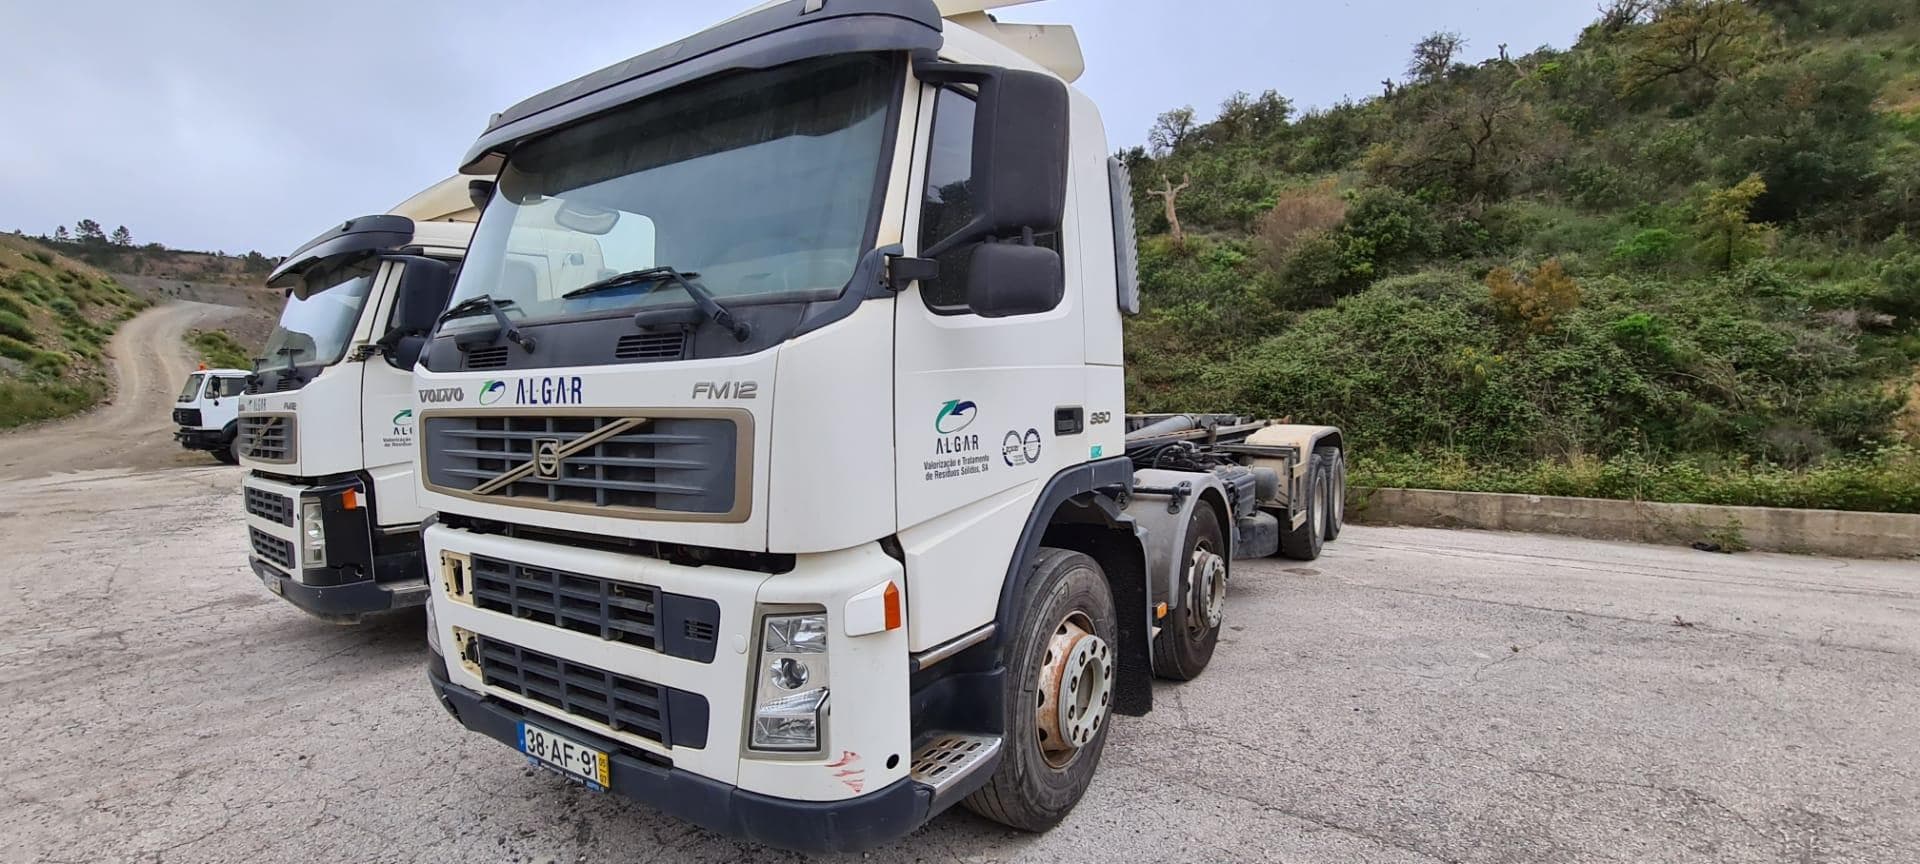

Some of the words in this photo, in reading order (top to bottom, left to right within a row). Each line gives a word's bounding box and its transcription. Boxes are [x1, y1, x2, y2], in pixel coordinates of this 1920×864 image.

[418, 387, 464, 403] VOLVO
[692, 381, 758, 400] FM12
[962, 454, 989, 465] Tratamento
[925, 472, 933, 481] de
